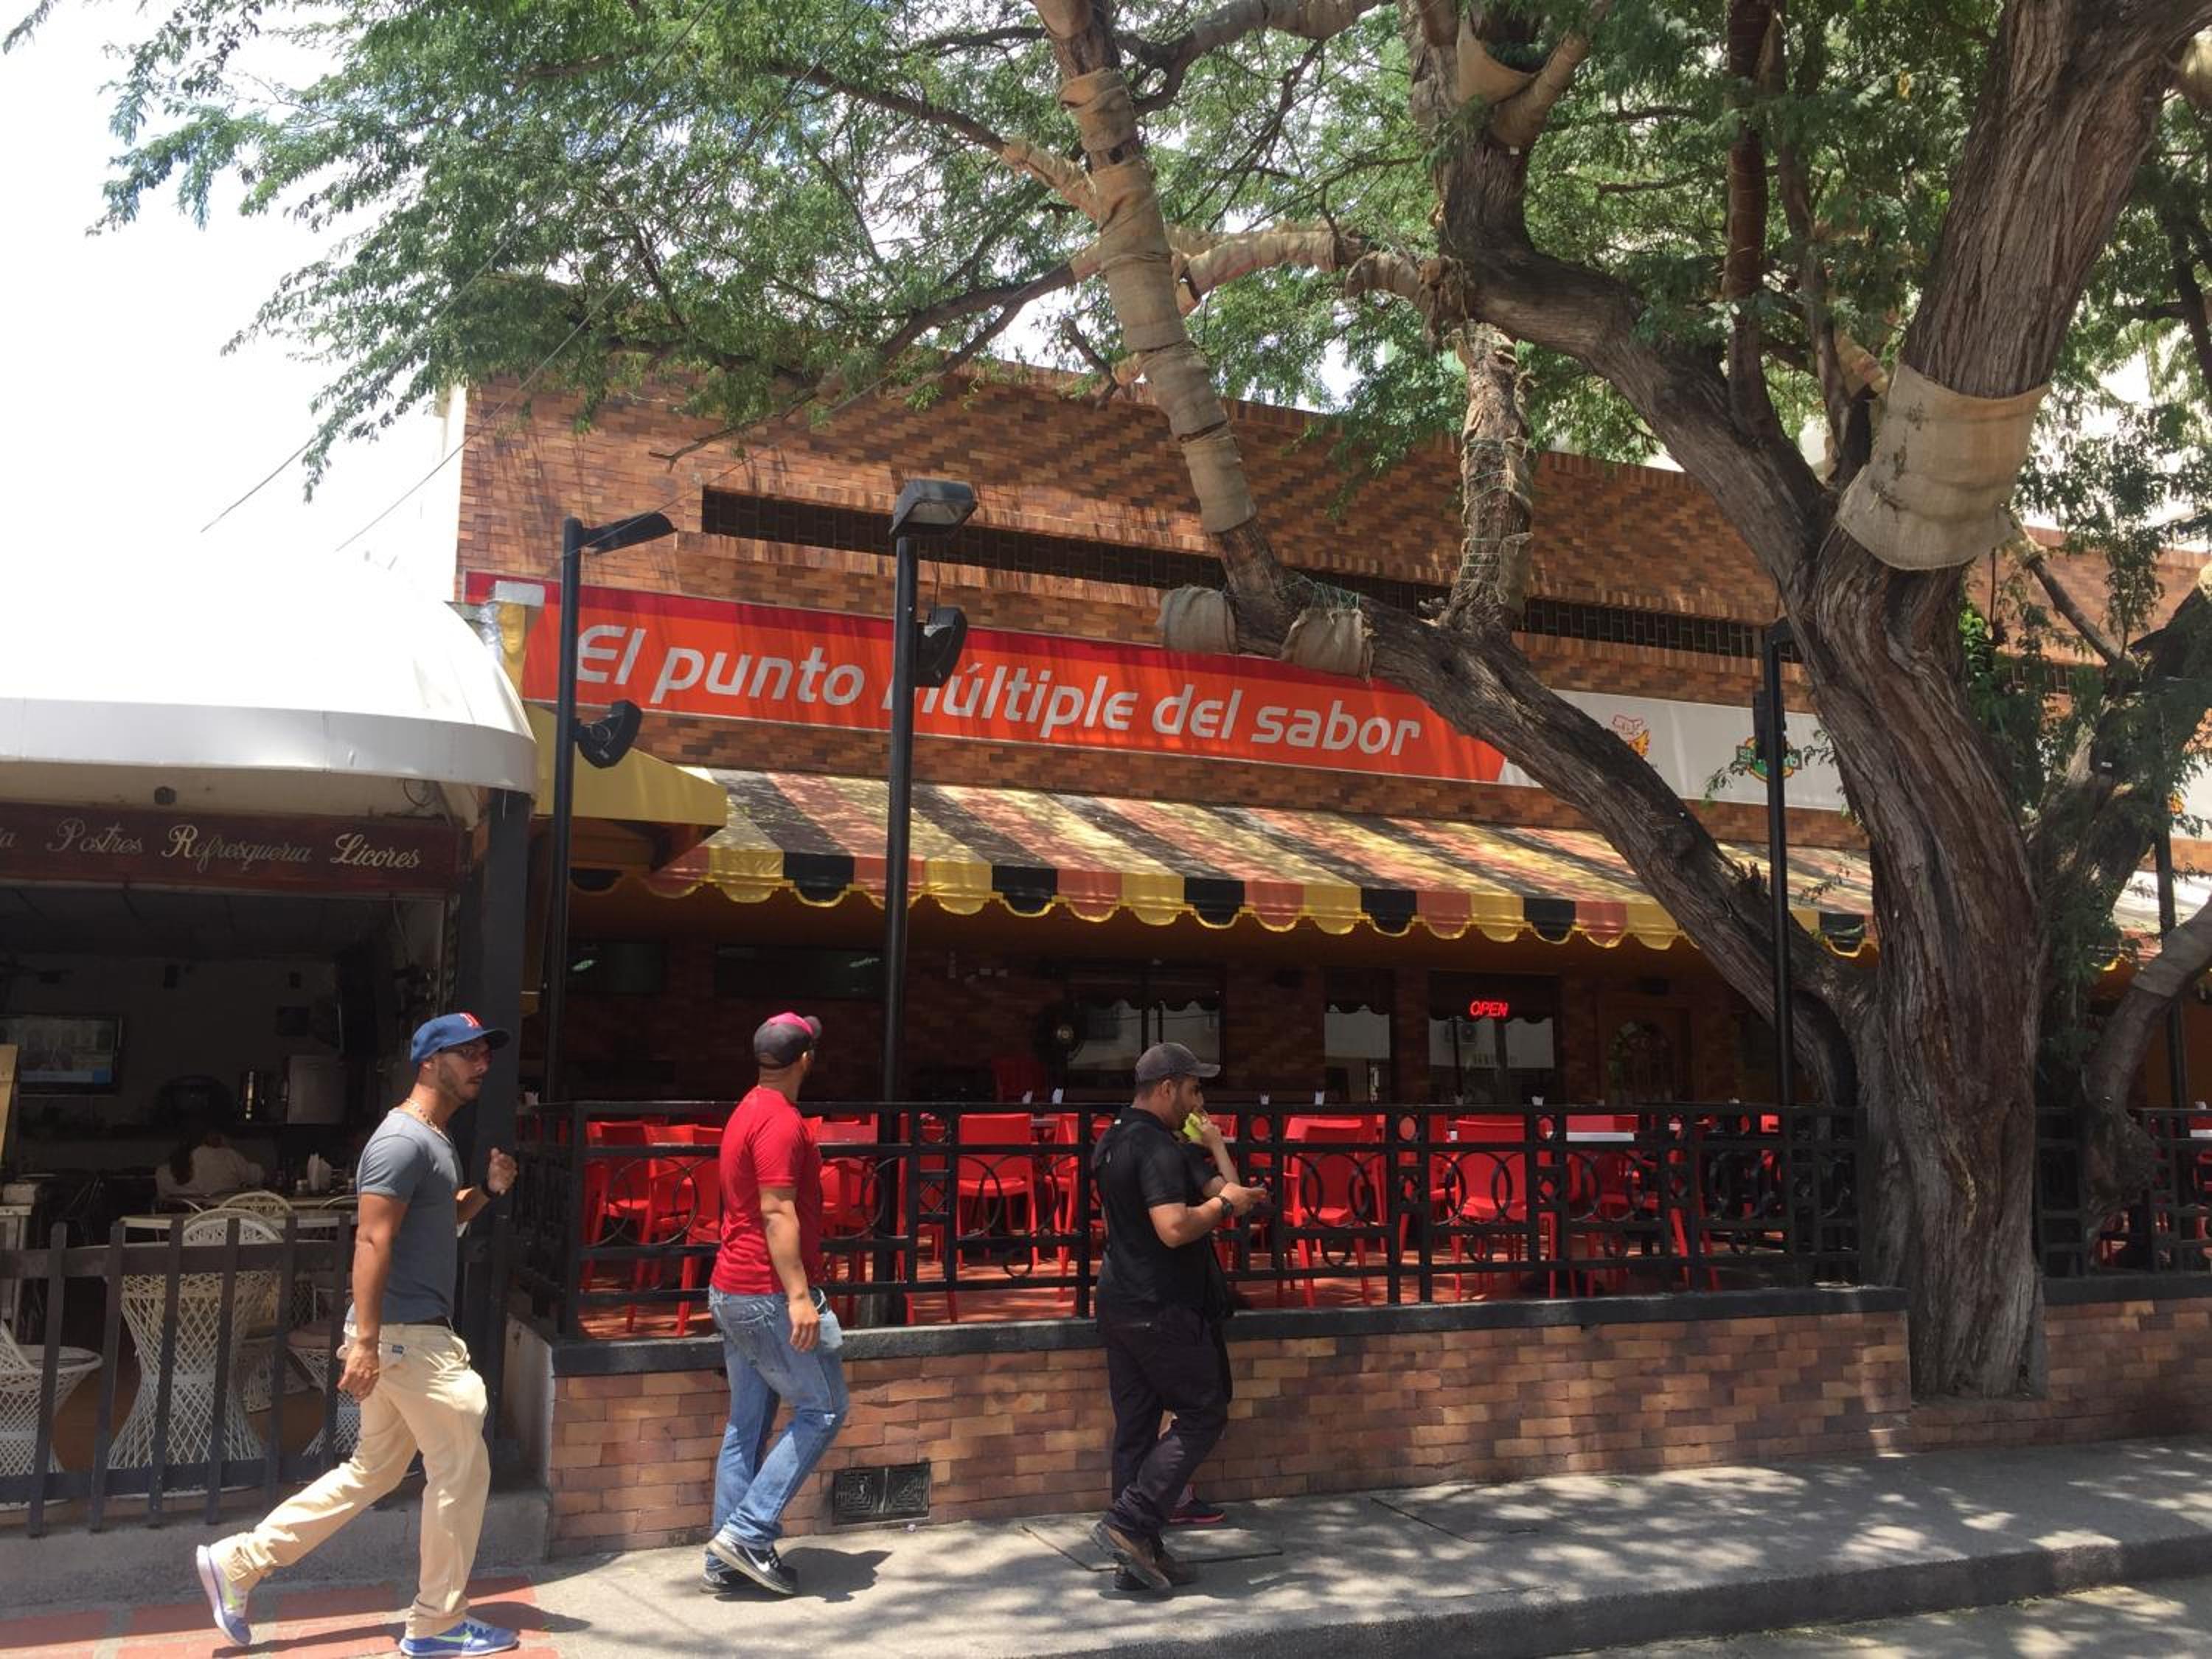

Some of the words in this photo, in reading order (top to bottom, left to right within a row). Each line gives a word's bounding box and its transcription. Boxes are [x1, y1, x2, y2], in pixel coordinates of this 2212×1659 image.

[577, 625, 647, 686] El
[650, 645, 865, 706] punto
[1152, 684, 1243, 740] del
[1251, 699, 1422, 757] sabor
[44, 817, 143, 853] Postres
[330, 832, 421, 868] Licores
[1470, 1001, 1509, 1018] OPEN
